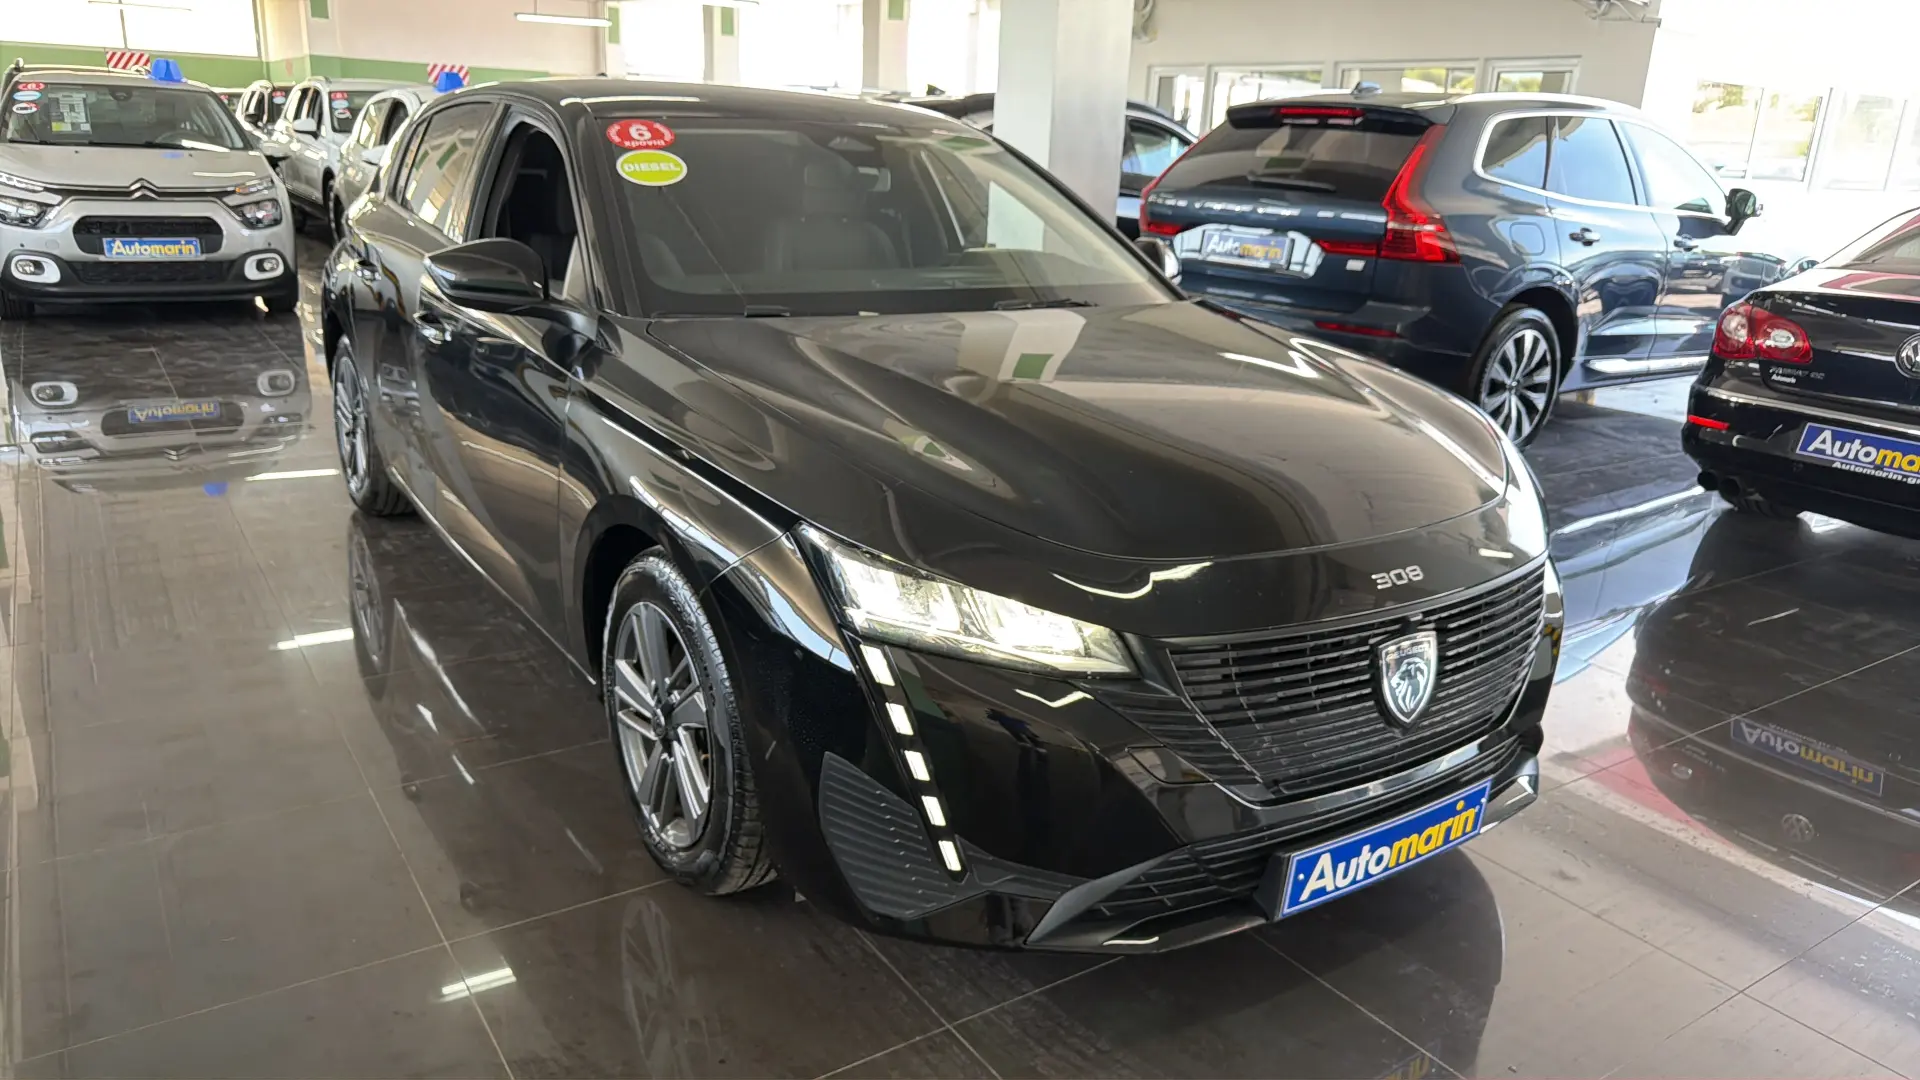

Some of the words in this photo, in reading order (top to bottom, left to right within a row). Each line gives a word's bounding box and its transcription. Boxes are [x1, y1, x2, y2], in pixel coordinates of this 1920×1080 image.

[629, 123, 652, 141] 6
[623, 162, 681, 172] DIESEL
[112, 239, 196, 256] Automarin
[1207, 234, 1281, 258] Automarin
[1371, 565, 1424, 590] 308
[1299, 799, 1476, 901] Automarin
